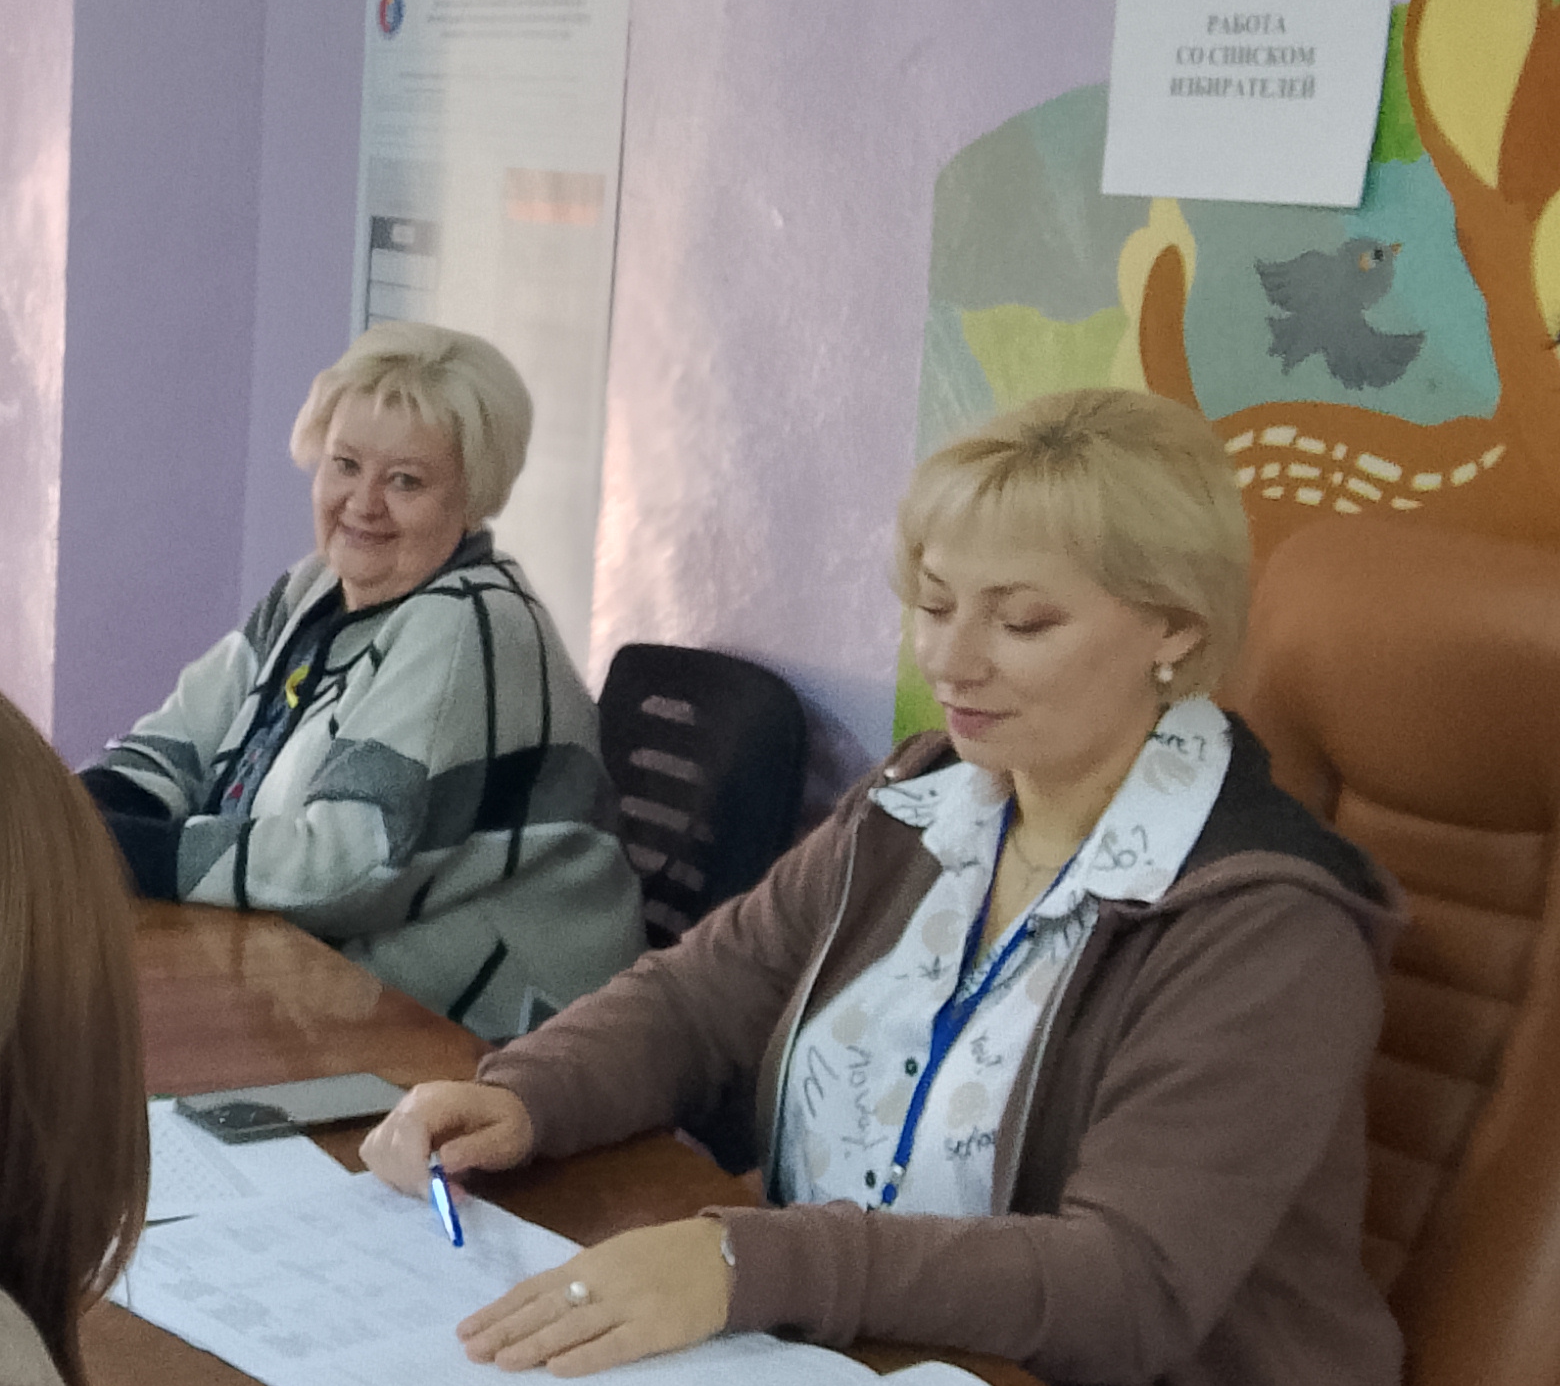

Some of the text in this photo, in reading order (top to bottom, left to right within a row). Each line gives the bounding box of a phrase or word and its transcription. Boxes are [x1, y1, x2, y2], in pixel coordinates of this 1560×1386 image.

[1207, 14, 1286, 35] РАБОТА
[1176, 45, 1316, 66] СО СПИСКОМ
[1170, 75, 1315, 99] ИЗБИРАТЕЛЕЙ
